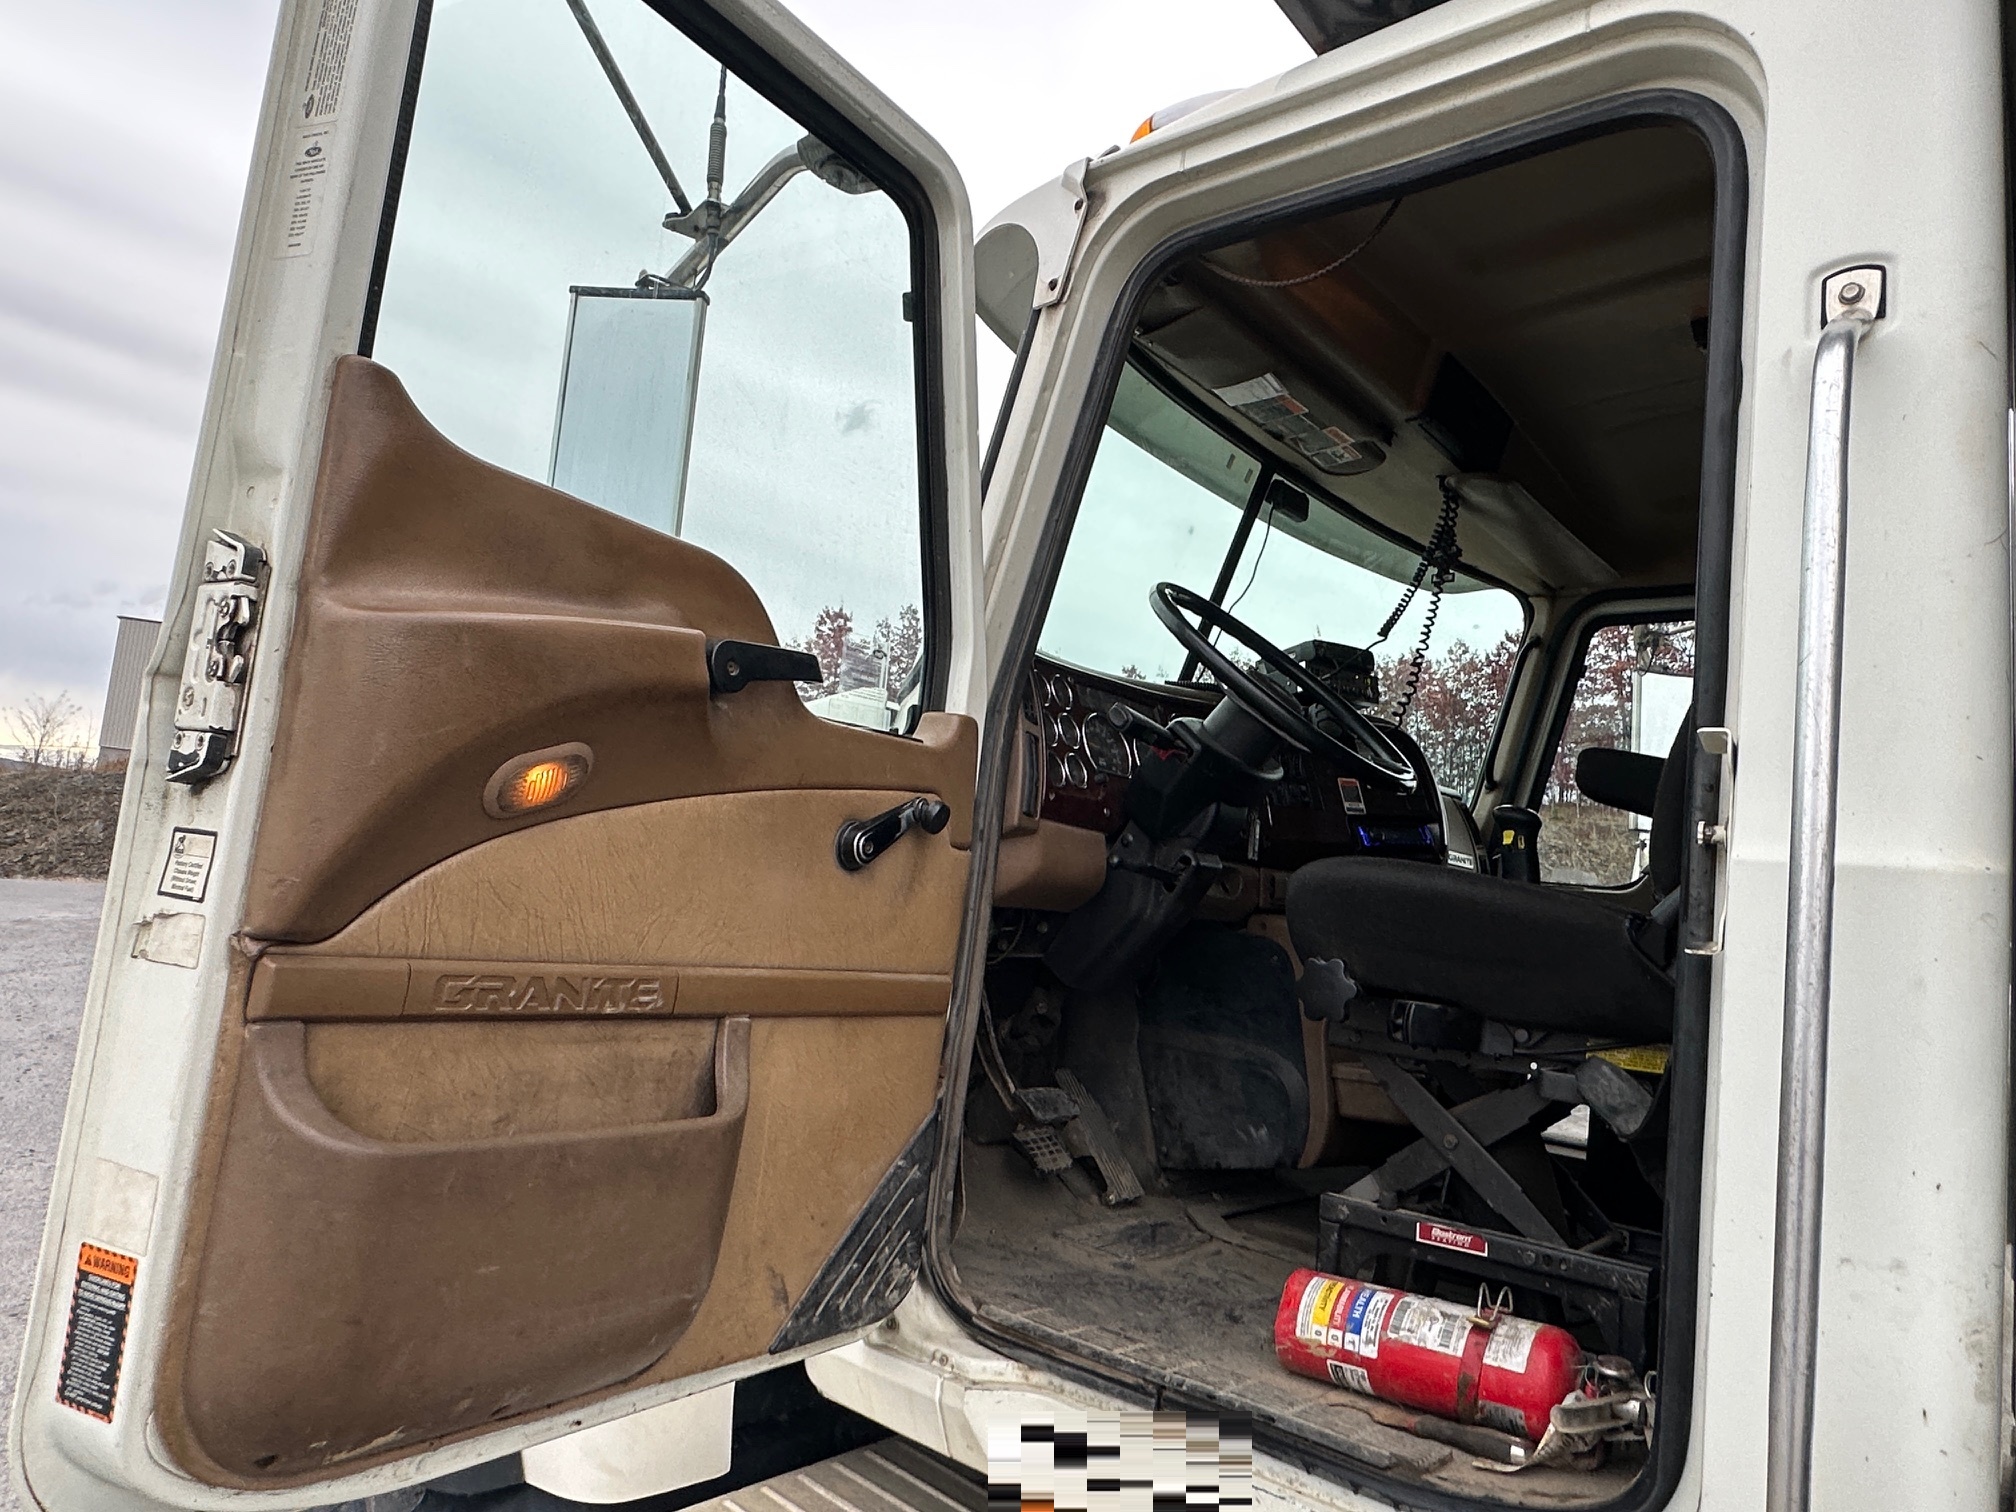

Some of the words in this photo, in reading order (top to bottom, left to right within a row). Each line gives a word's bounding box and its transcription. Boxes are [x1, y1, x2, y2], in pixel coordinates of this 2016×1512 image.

[433, 974, 664, 1014] GRANITE
[1431, 1226, 1474, 1243] Bostrom
[92, 1255, 131, 1279] WARNING
[1352, 1288, 1372, 1319] HEALTH
